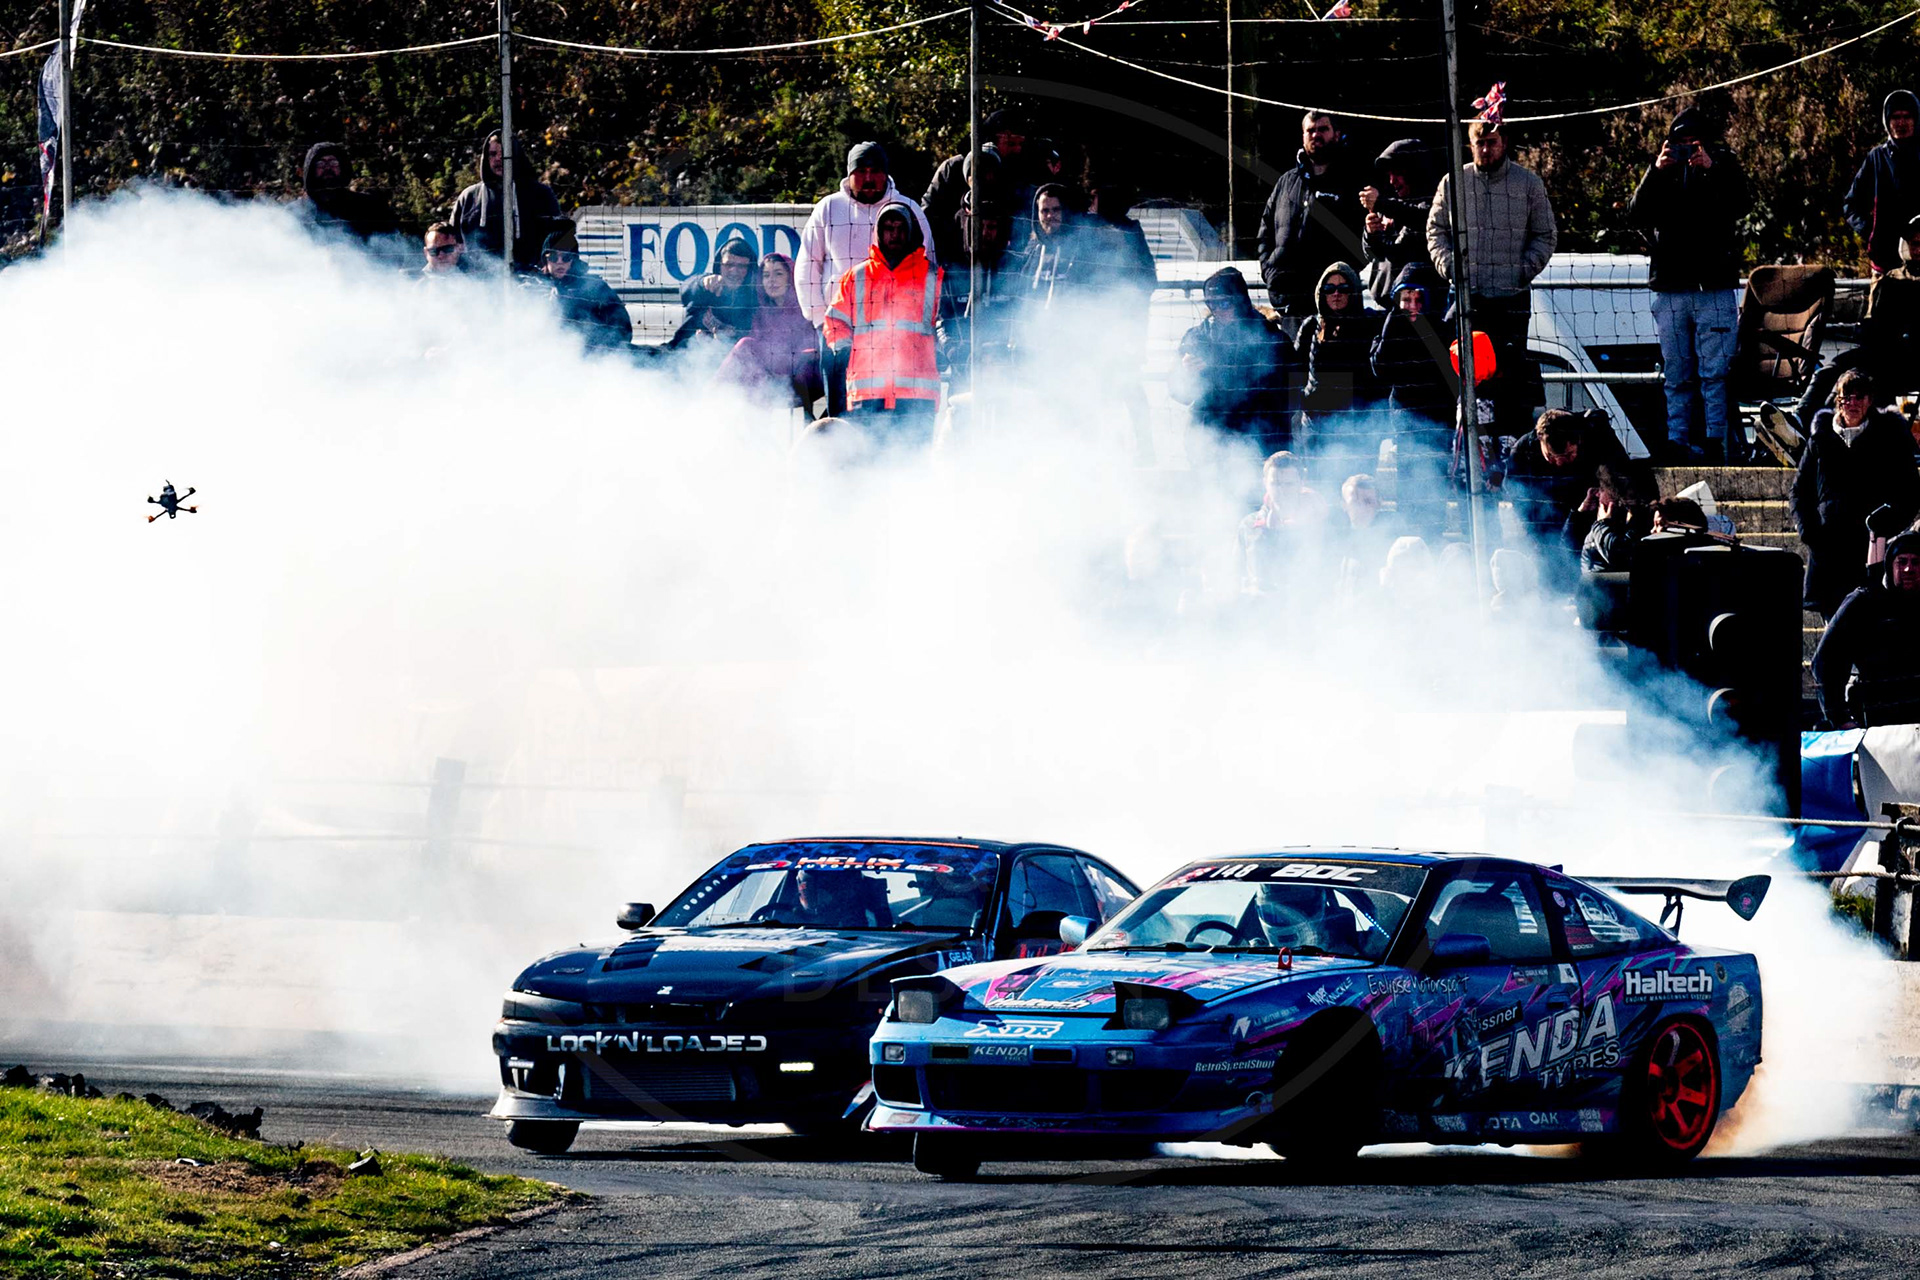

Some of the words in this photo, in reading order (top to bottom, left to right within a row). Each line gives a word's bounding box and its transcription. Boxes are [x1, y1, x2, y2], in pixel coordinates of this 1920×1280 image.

[1209, 864, 1260, 879] 148
[948, 951, 975, 963] GEAR
[1624, 968, 1713, 995] Haltech
[1443, 990, 1620, 1089] KENDA
[974, 1046, 1028, 1056] KENDA
[1539, 1040, 1621, 1090] TYRES
[1528, 1111, 1560, 1125] OAK
